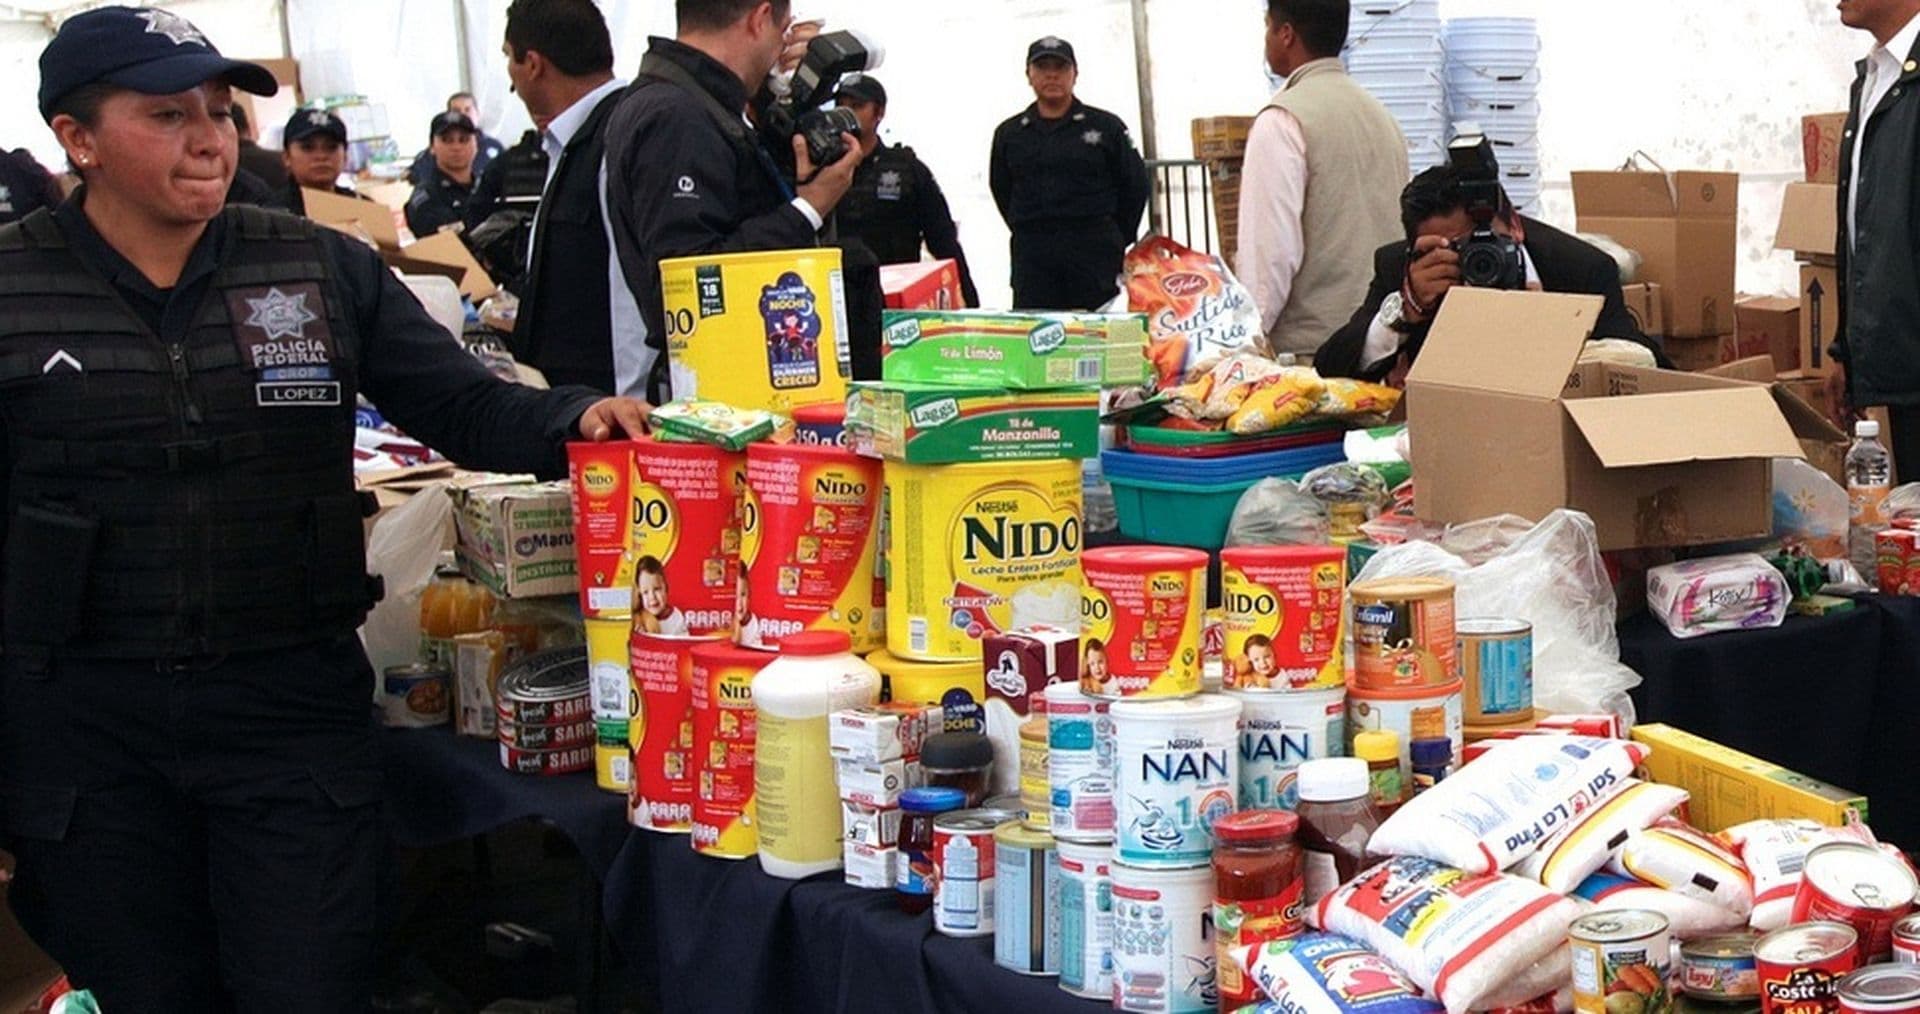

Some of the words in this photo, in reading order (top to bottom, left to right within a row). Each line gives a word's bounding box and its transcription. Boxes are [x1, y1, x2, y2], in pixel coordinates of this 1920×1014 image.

[702, 284, 719, 297] 18
[251, 339, 326, 356] POLICÍA
[964, 345, 1003, 361] Limón
[254, 351, 330, 368] FEDERAL
[273, 387, 328, 401] LOPEZ
[982, 428, 1060, 442] Manzanilla
[815, 478, 867, 496] NIDO
[962, 516, 1080, 560] NIDO
[971, 566, 1005, 577] Leche
[1007, 564, 1040, 574] Entera
[1142, 750, 1228, 782] NAN
[1588, 767, 1616, 797] Sal
[1543, 803, 1570, 829] La
[1505, 821, 1545, 852] Fina
